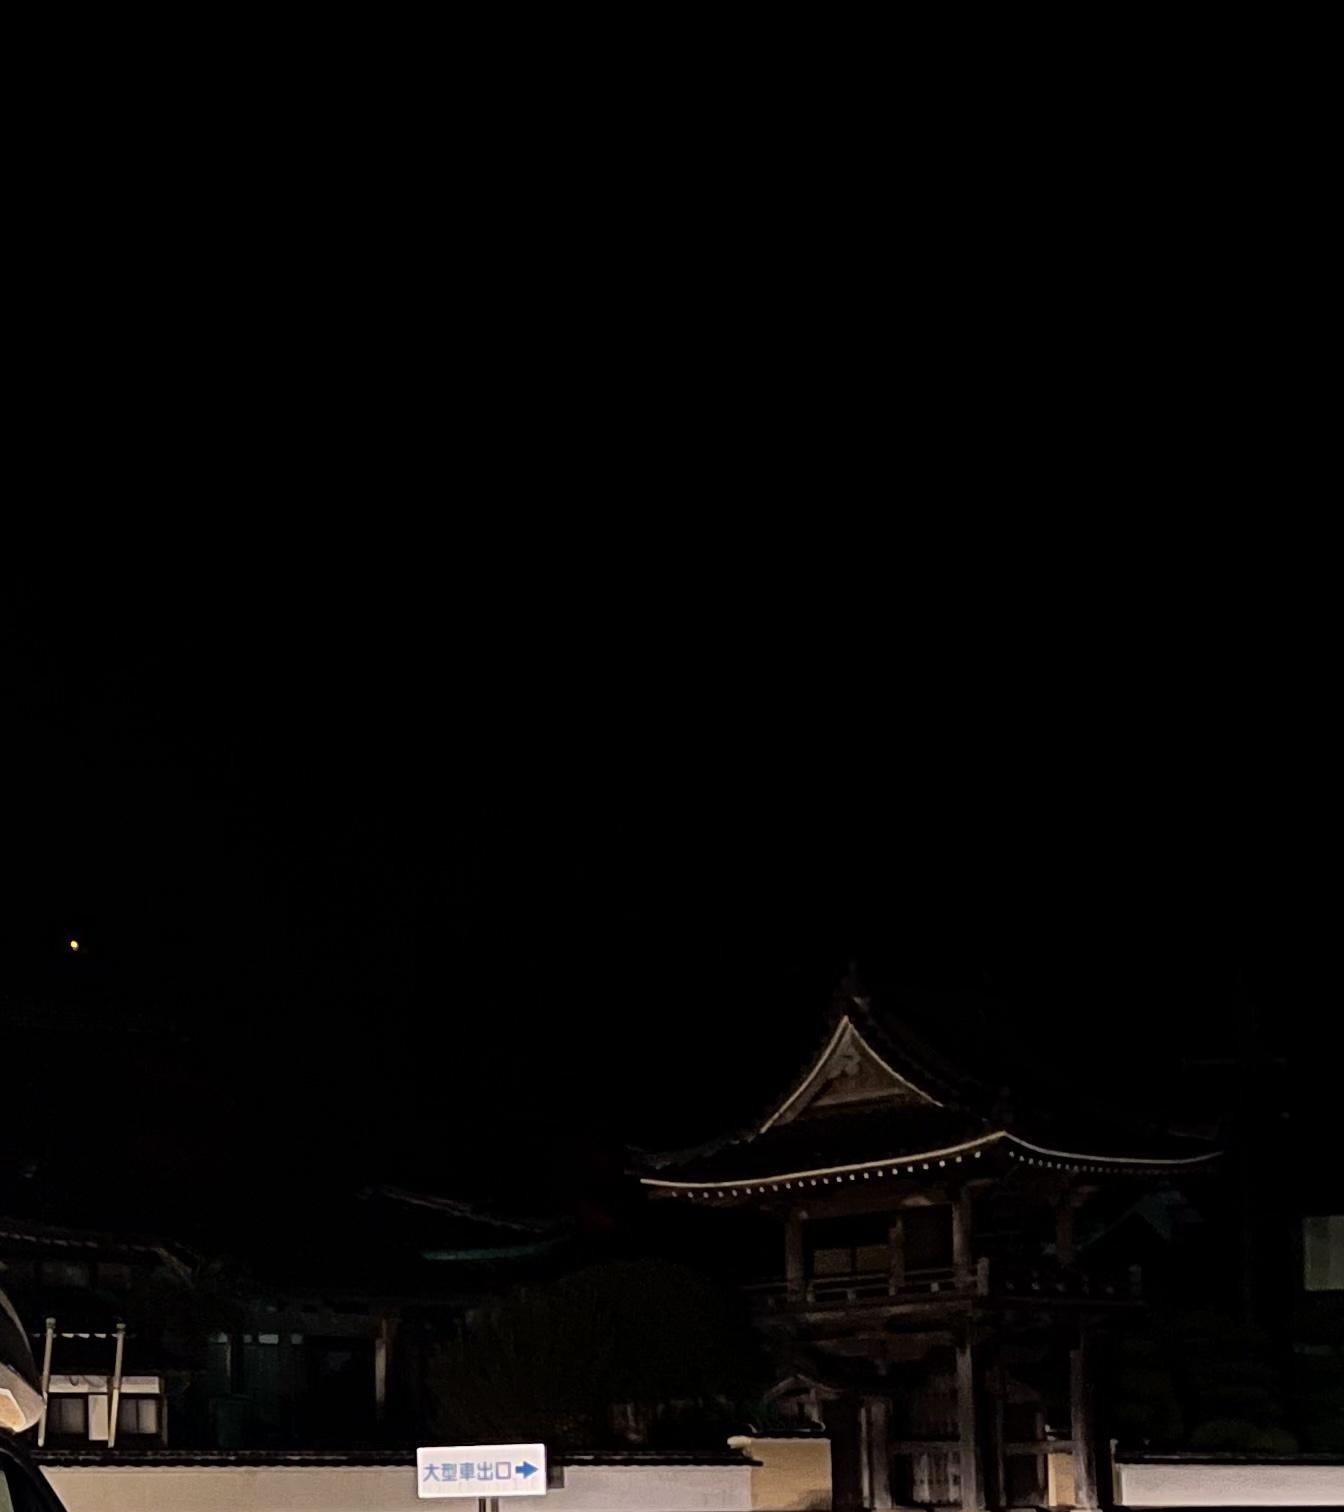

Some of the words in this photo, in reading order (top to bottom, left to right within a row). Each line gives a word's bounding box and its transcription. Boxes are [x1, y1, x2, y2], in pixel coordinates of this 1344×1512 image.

[422, 1461, 512, 1483] 大型車出口
